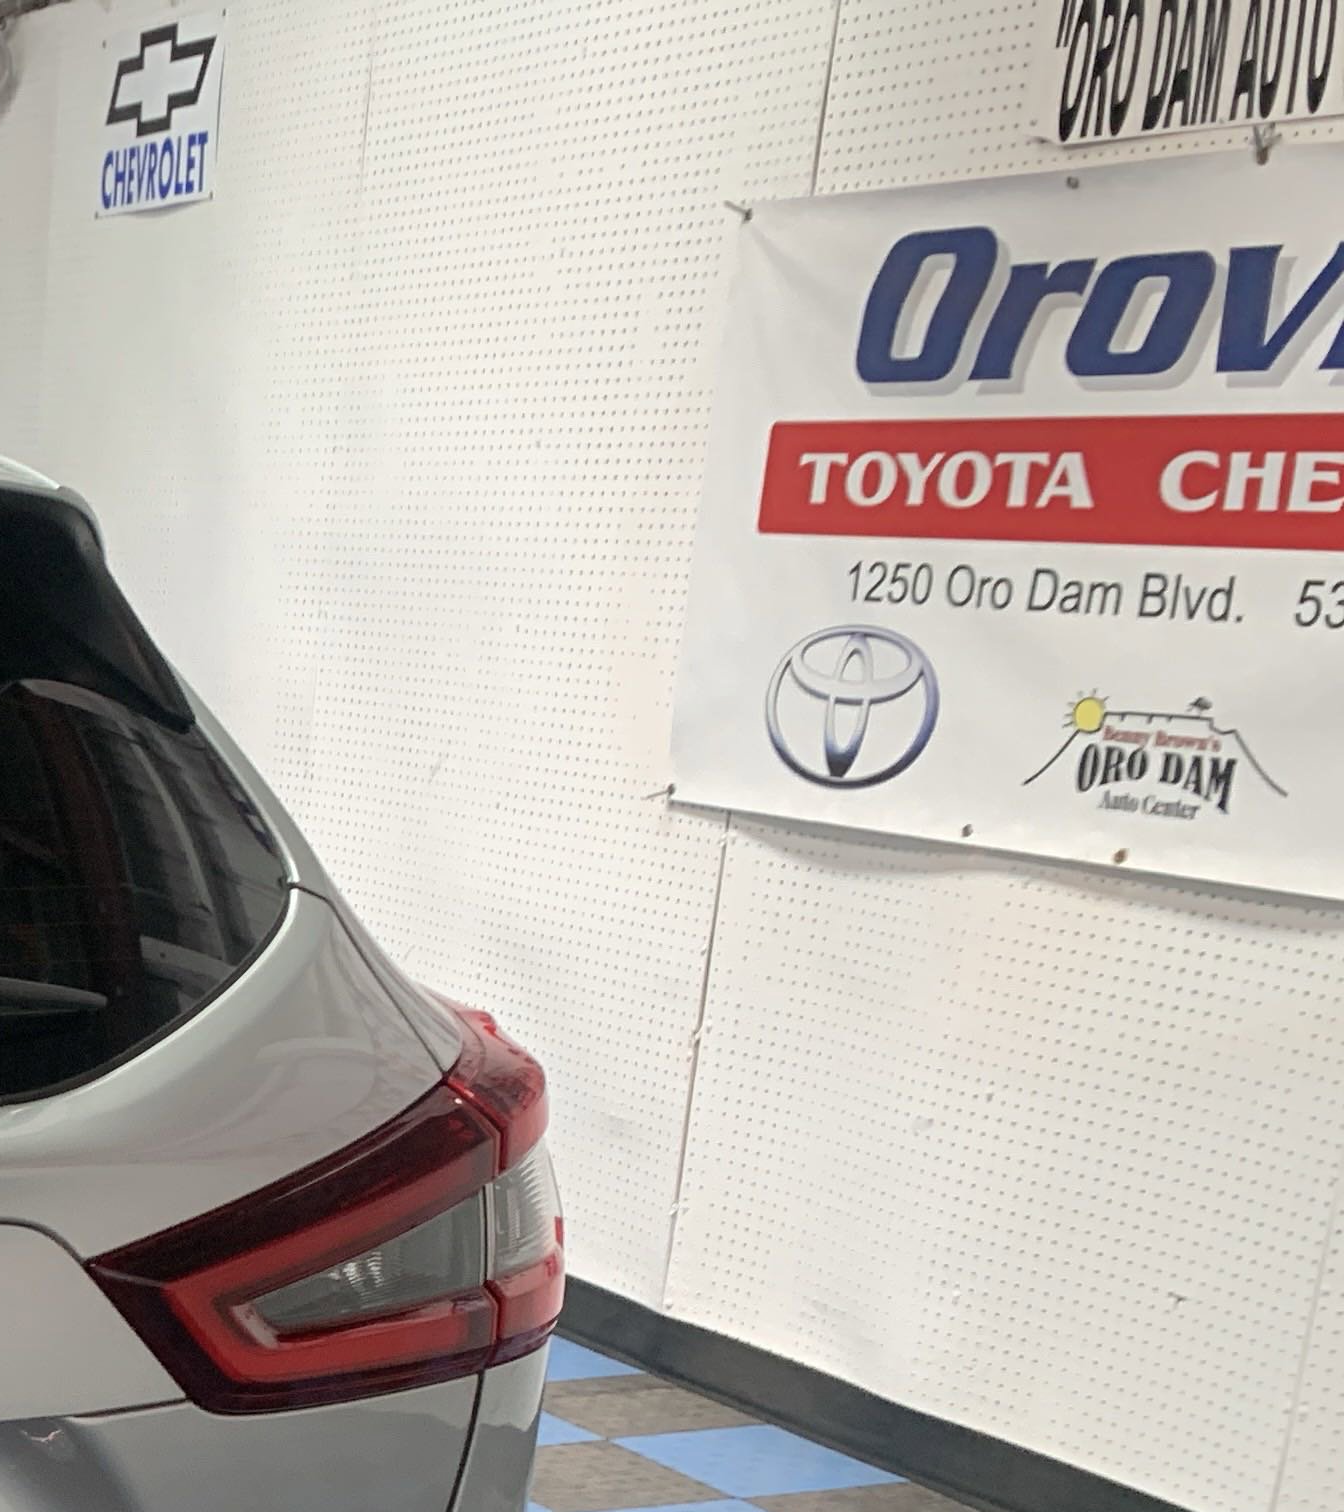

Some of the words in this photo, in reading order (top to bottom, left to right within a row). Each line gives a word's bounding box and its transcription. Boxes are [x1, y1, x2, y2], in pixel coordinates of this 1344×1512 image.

[1141, 0, 1231, 131] DAM
[101, 132, 208, 209] CHEVROLET
[799, 451, 1094, 510] TOYOTA
[847, 560, 933, 606] 1250
[945, 565, 1013, 612] Oro
[1027, 569, 1122, 618] Dam
[1139, 573, 1245, 624] Blvd.
[1076, 743, 1148, 793] ORO
[1159, 752, 1237, 814] DAM
[1099, 790, 1139, 812] Auto
[1142, 795, 1201, 820] Center
